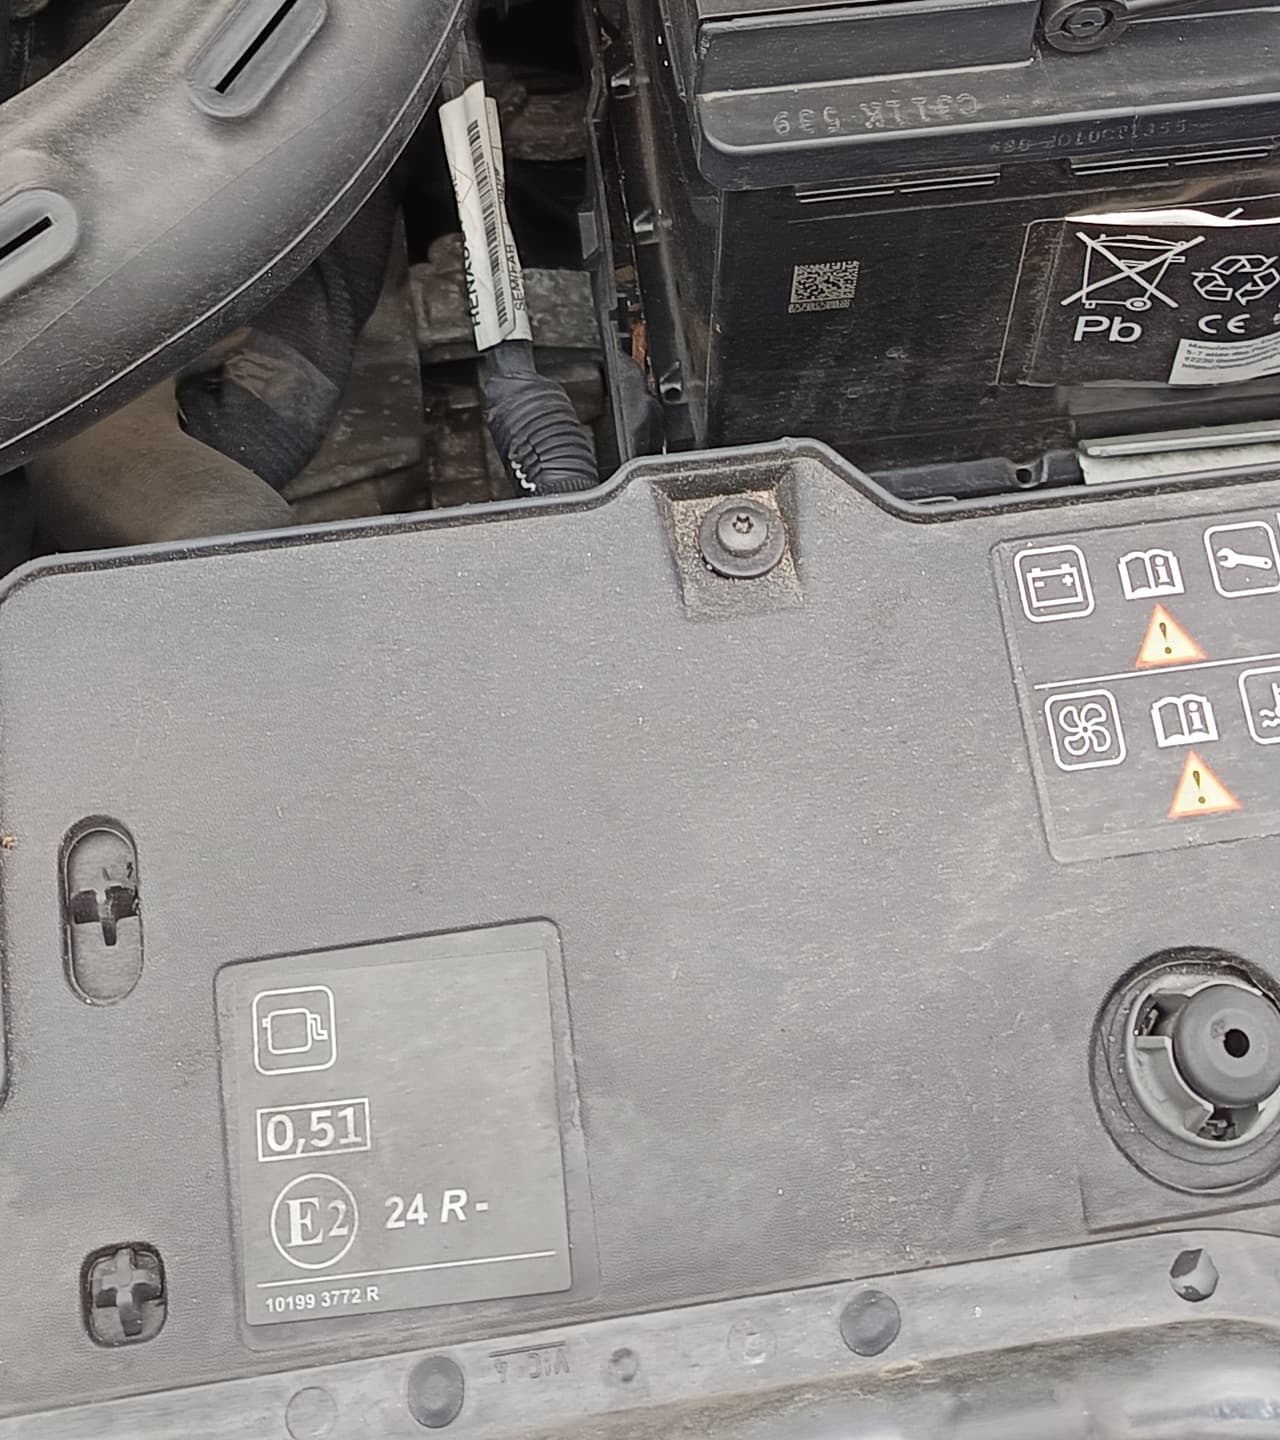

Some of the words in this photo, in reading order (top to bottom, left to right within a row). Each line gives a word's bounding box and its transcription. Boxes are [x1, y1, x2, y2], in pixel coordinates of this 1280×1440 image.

[1073, 315, 1144, 343] Pb
[266, 1106, 363, 1155] 0,51
[384, 1192, 428, 1230] 24
[265, 1293, 316, 1313] 10199
[321, 1288, 362, 1307] 3772
[366, 1285, 380, 1302] R
